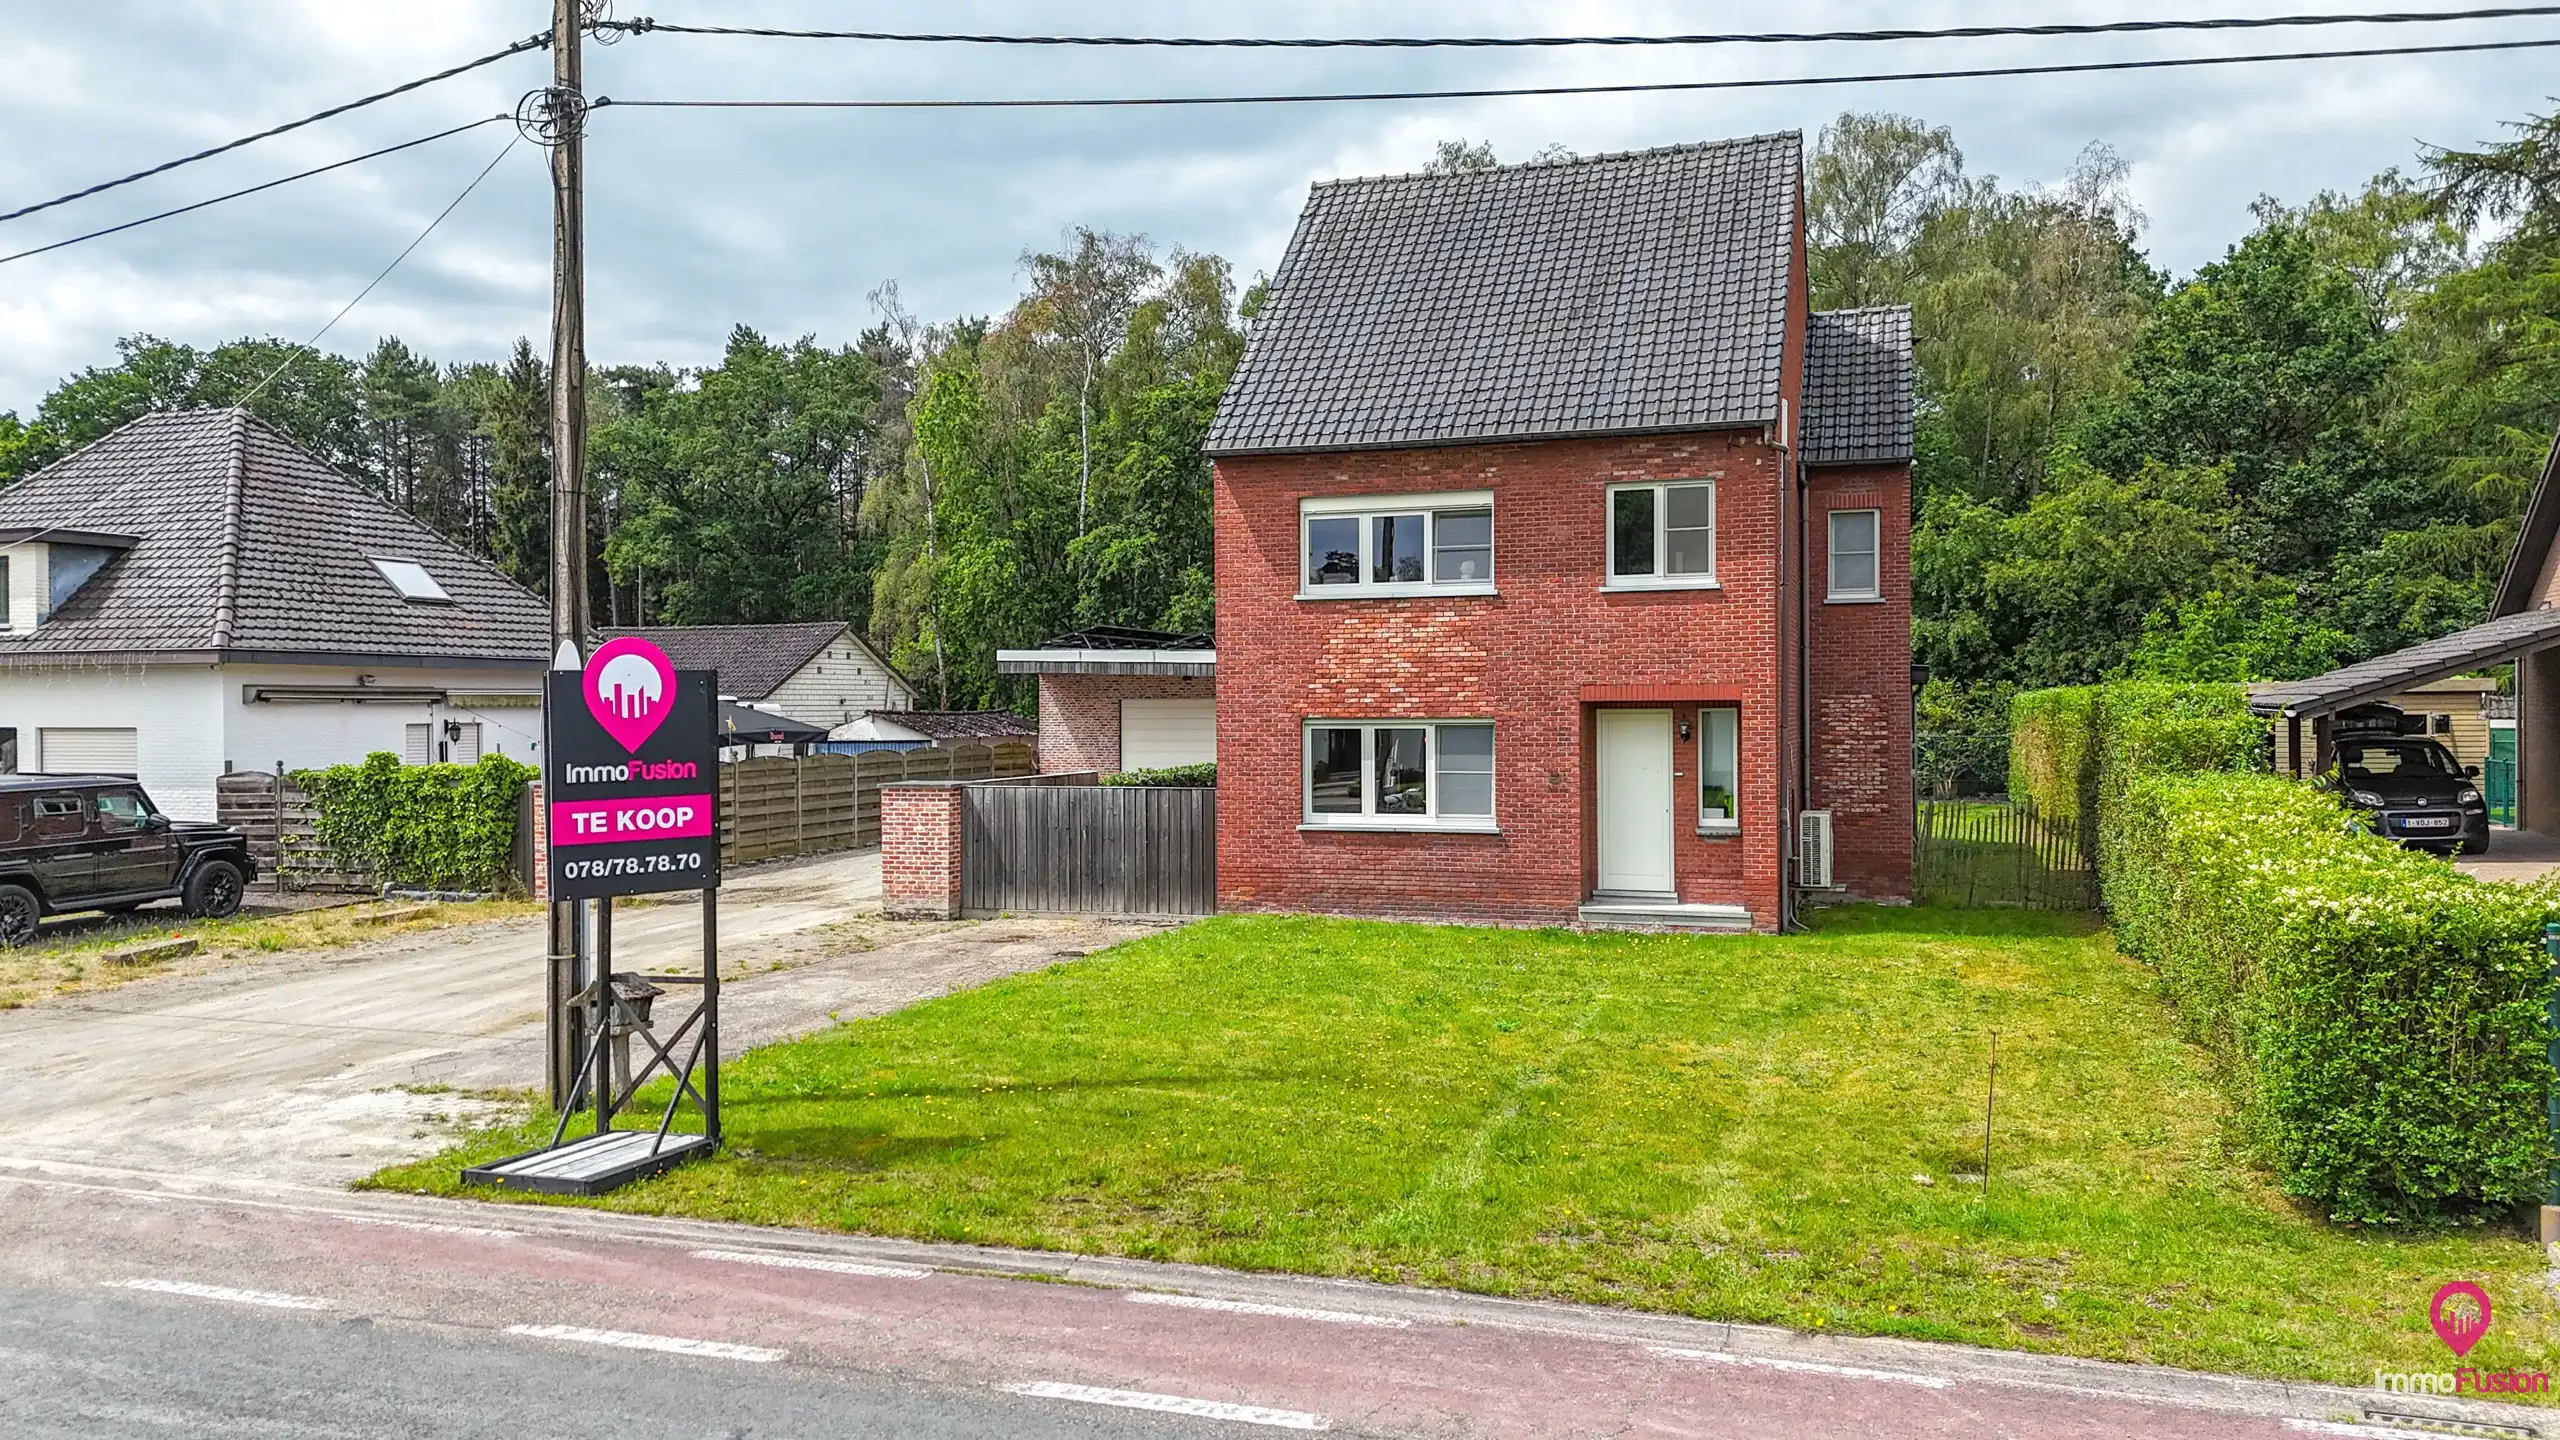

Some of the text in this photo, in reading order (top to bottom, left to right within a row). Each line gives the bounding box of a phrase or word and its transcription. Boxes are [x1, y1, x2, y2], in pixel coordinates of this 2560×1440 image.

[566, 759, 697, 784] ImmoFusion
[571, 807, 694, 834] TE KOOP
[564, 853, 701, 878] 078/78.78.70
